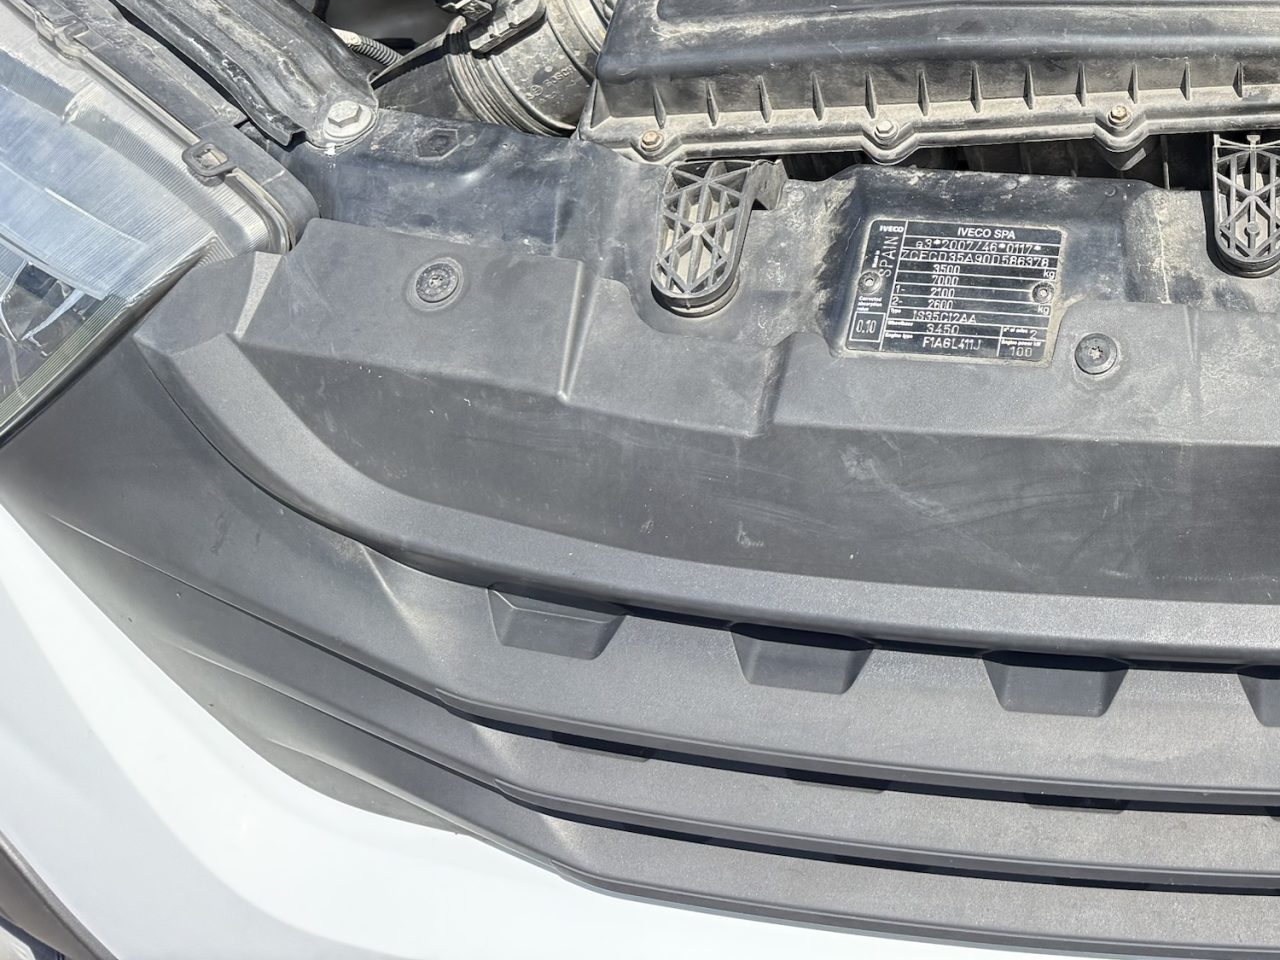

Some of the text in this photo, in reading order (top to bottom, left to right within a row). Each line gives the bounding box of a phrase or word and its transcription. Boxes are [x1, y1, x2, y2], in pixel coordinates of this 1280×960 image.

[879, 225, 904, 233] IVECO
[957, 227, 1016, 240] IVECO SPA
[879, 236, 900, 277] SPAIN
[933, 265, 1056, 280] 3500 kg
[931, 276, 959, 286] 7000
[930, 288, 955, 297] 2100
[927, 300, 954, 309] 2600
[1037, 305, 1050, 315] kg
[855, 319, 877, 334] 0.10
[926, 325, 960, 335] 3450
[1030, 329, 1038, 339] 2
[1009, 347, 1033, 357] 100
